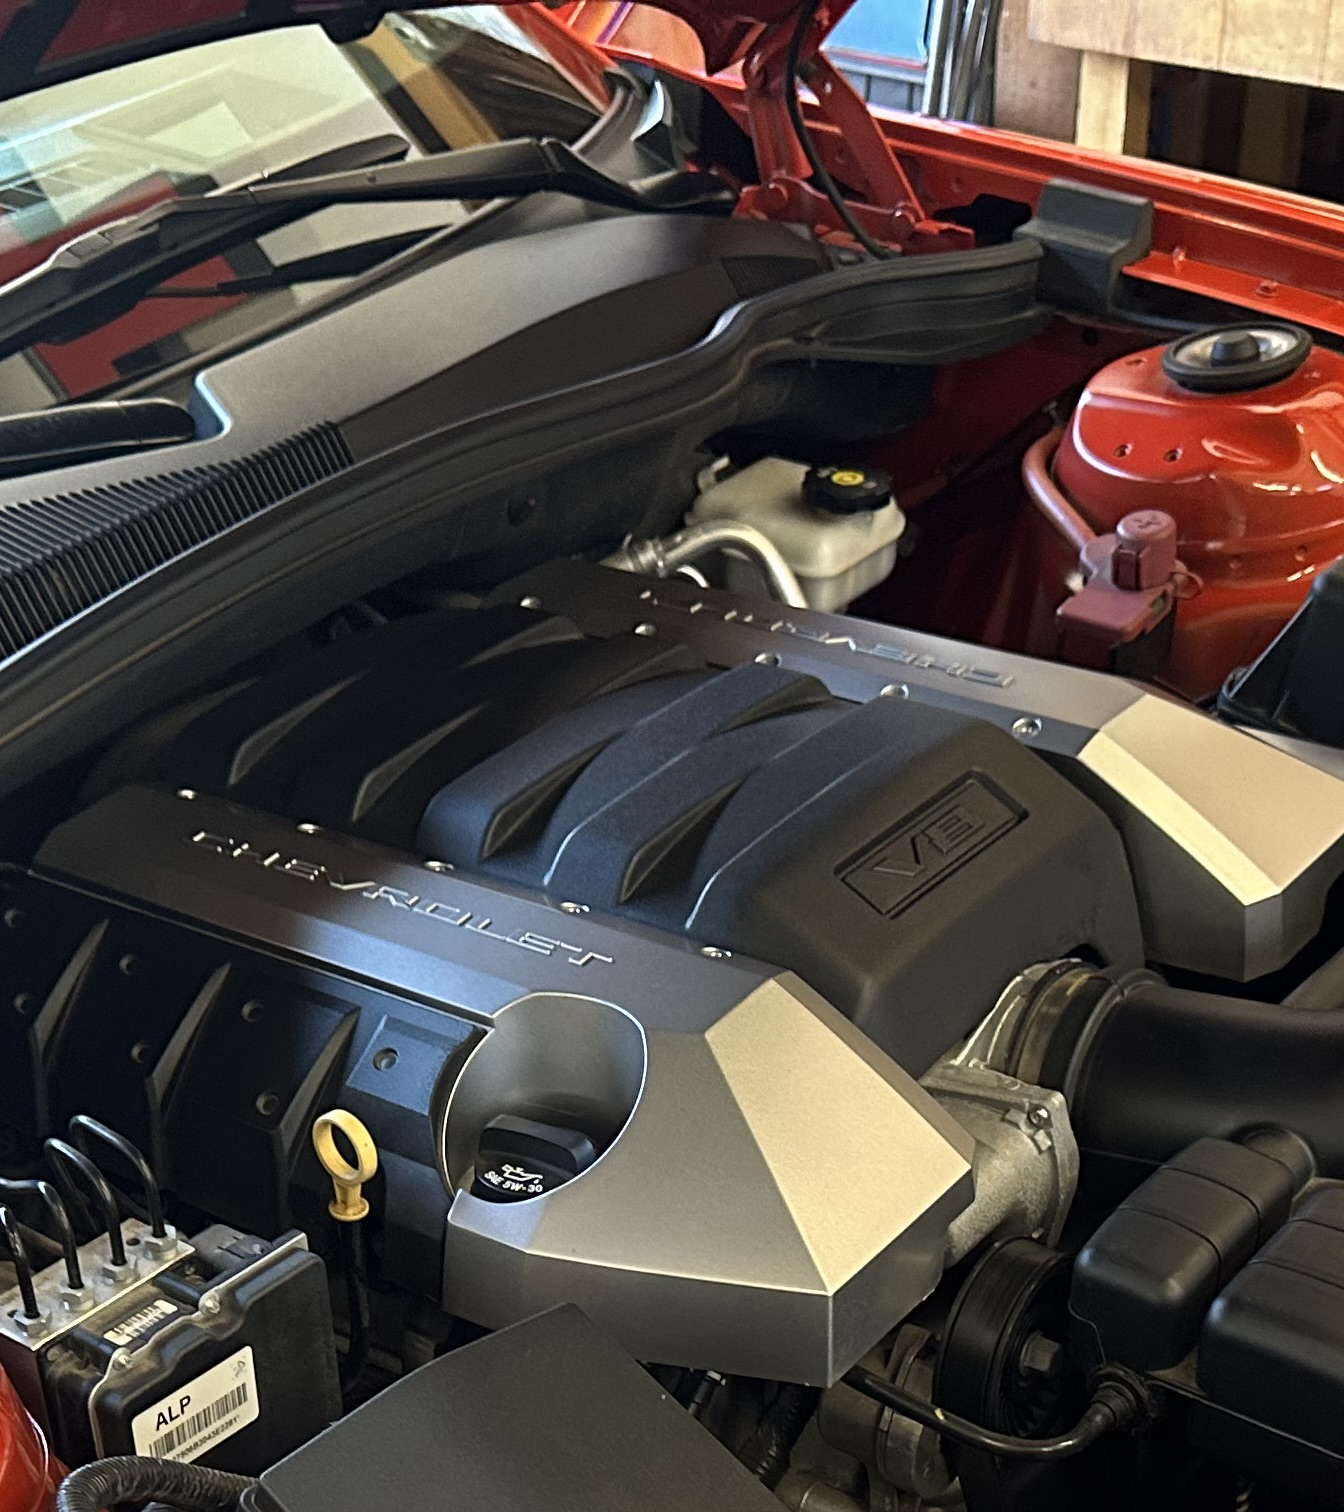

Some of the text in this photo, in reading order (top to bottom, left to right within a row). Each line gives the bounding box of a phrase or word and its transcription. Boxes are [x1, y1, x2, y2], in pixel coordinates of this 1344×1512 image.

[639, 589, 1015, 689] CHEVRO
[871, 802, 987, 878] V8
[191, 829, 614, 968] CHEVROLET
[484, 1171, 543, 1193] SAE 5W-30
[155, 1395, 191, 1431] ALP
